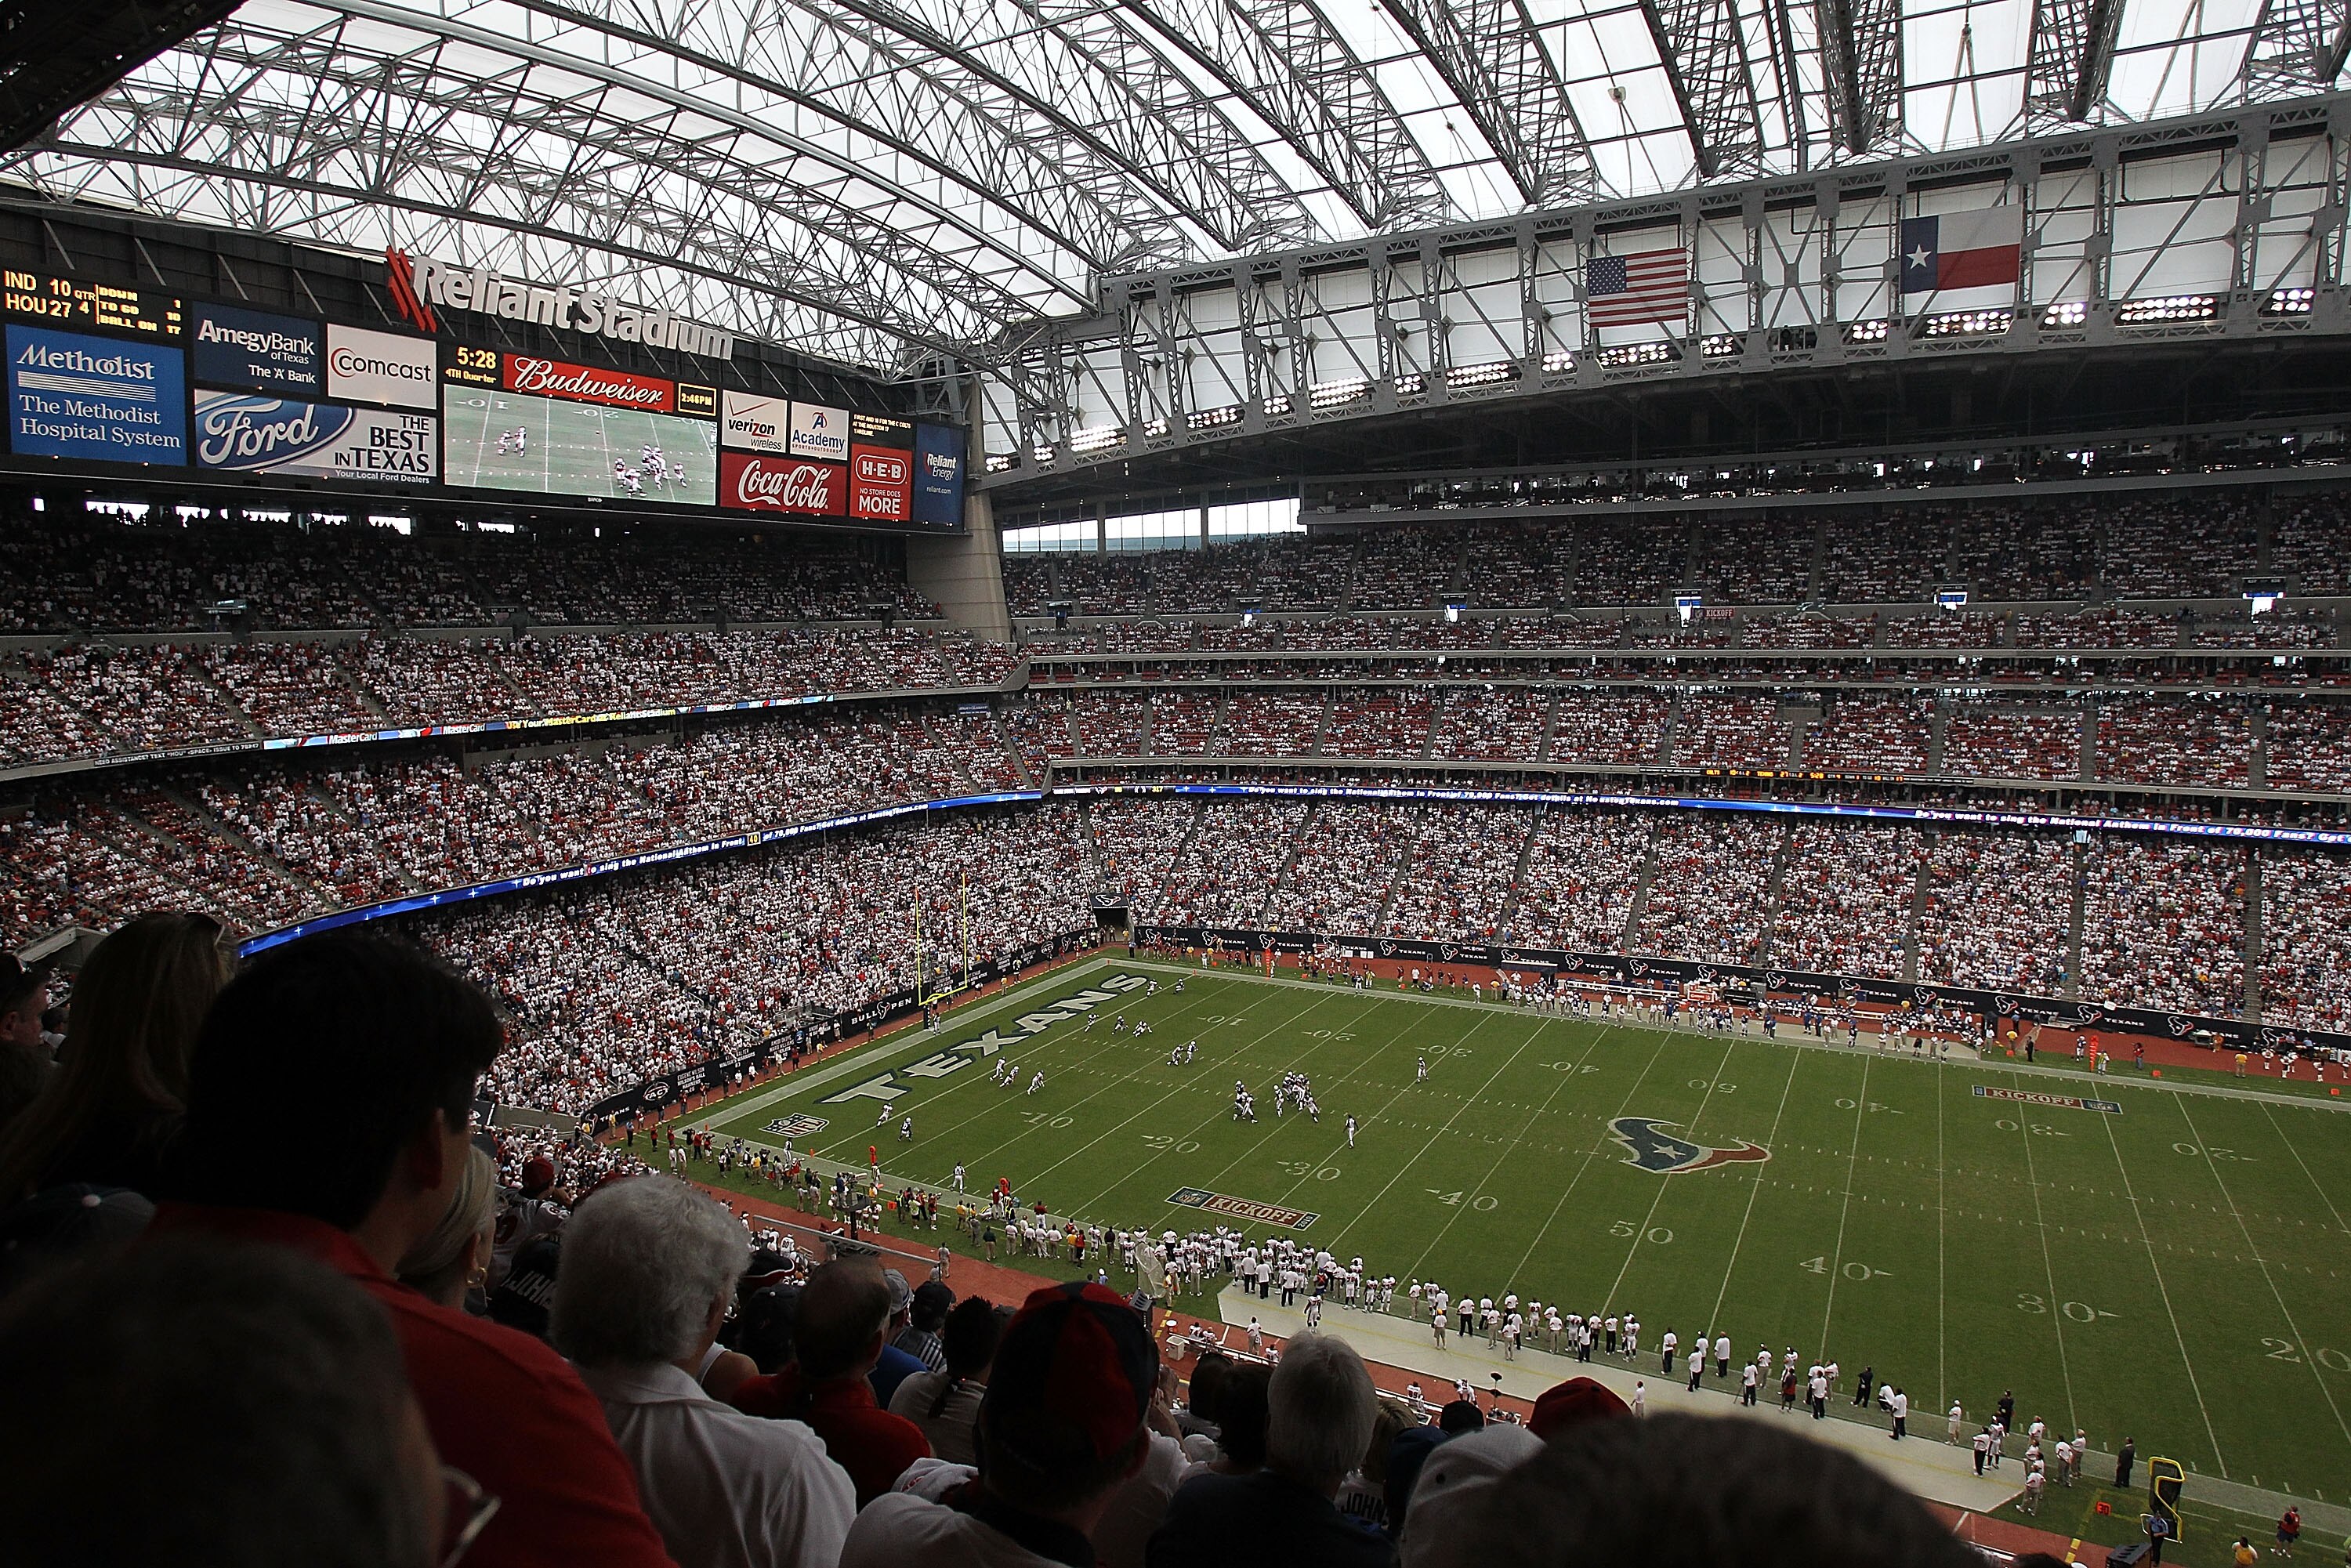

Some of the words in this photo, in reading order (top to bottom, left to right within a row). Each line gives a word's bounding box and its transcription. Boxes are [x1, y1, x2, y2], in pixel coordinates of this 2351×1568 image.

[4, 270, 37, 291] IND
[49, 278, 71, 297] 10
[5, 292, 46, 314] HOU
[49, 300, 72, 318] 27
[74, 289, 96, 301] QTR
[99, 287, 138, 302] DOWN
[174, 299, 181, 309] 1
[78, 301, 89, 314] 4
[100, 300, 118, 312] TO
[120, 304, 139, 315] GO
[166, 311, 181, 322] 10
[413, 255, 573, 329] Reliant
[576, 292, 734, 360] Stadium
[100, 315, 135, 328] BALL
[138, 320, 157, 331] ON
[166, 324, 182, 335] 17
[198, 319, 315, 356] AmegyBank
[16, 344, 155, 380] Methodist
[271, 352, 282, 360] of
[283, 353, 309, 364] Texas
[457, 346, 496, 370] 5:28
[248, 364, 271, 378] The
[288, 371, 316, 384] Bank
[445, 368, 462, 378] 4TH
[463, 371, 496, 384] Quarter
[514, 357, 664, 404] Budweiser
[20, 394, 60, 415] The
[64, 399, 161, 425] Methodist
[681, 393, 712, 406] 2:46PM
[20, 418, 107, 441] Hospital
[111, 427, 181, 448] System
[200, 400, 318, 464] Ford
[399, 415, 429, 430] THE
[728, 418, 776, 438] verizon
[371, 426, 429, 451] BEST
[751, 438, 782, 450] wireless
[792, 429, 845, 452] Academy
[335, 452, 350, 465] IN
[350, 447, 429, 473] TEXAS
[927, 454, 956, 469] Reliant
[357, 471, 378, 480] Local
[380, 473, 399, 481] Ford
[401, 475, 429, 483] Dealers
[738, 459, 831, 509] Coca-Cola
[933, 467, 954, 480] Energy
[926, 486, 951, 494] reliant.com
[859, 495, 900, 514] MORE
[329, 732, 378, 744] MasterCard
[443, 724, 485, 735] MasterCard
[111, 755, 148, 765] ASSISTANCE?
[1933, 811, 1952, 820] you
[2000, 815, 2025, 824] sing
[2050, 817, 2102, 827] National
[2103, 820, 2150, 830] Anthem
[2170, 824, 2204, 834] Front
[2208, 826, 2221, 835] of
[2226, 827, 2272, 838] 70,000
[2274, 830, 2313, 841] Fans?
[2318, 833, 2345, 842] Get
[749, 835, 758, 843] 40
[523, 877, 537, 886] Do
[538, 873, 557, 885] you
[560, 868, 584, 879] want
[600, 861, 619, 872] sing
[622, 857, 636, 867] the
[639, 849, 676, 864] National
[722, 839, 742, 849] Front
[851, 1011, 878, 1025] BULL
[891, 998, 912, 1010] PEN
[2020, 1007, 2059, 1016] TEXANS
[2104, 1018, 2145, 1027] TEXANS
[818, 974, 1148, 1104] TEXANS
[1992, 1088, 2075, 1106] KICKOFF
[1146, 1135, 1201, 1153] 20
[1291, 1161, 1341, 1181] 30
[1437, 1190, 1499, 1211] 40
[1210, 1197, 1297, 1222] KICKOFF
[1297, 1215, 1313, 1228] 2010
[1610, 1220, 1674, 1244] 50
[1800, 1255, 1871, 1280] 40
[2017, 1293, 2096, 1323] 30
